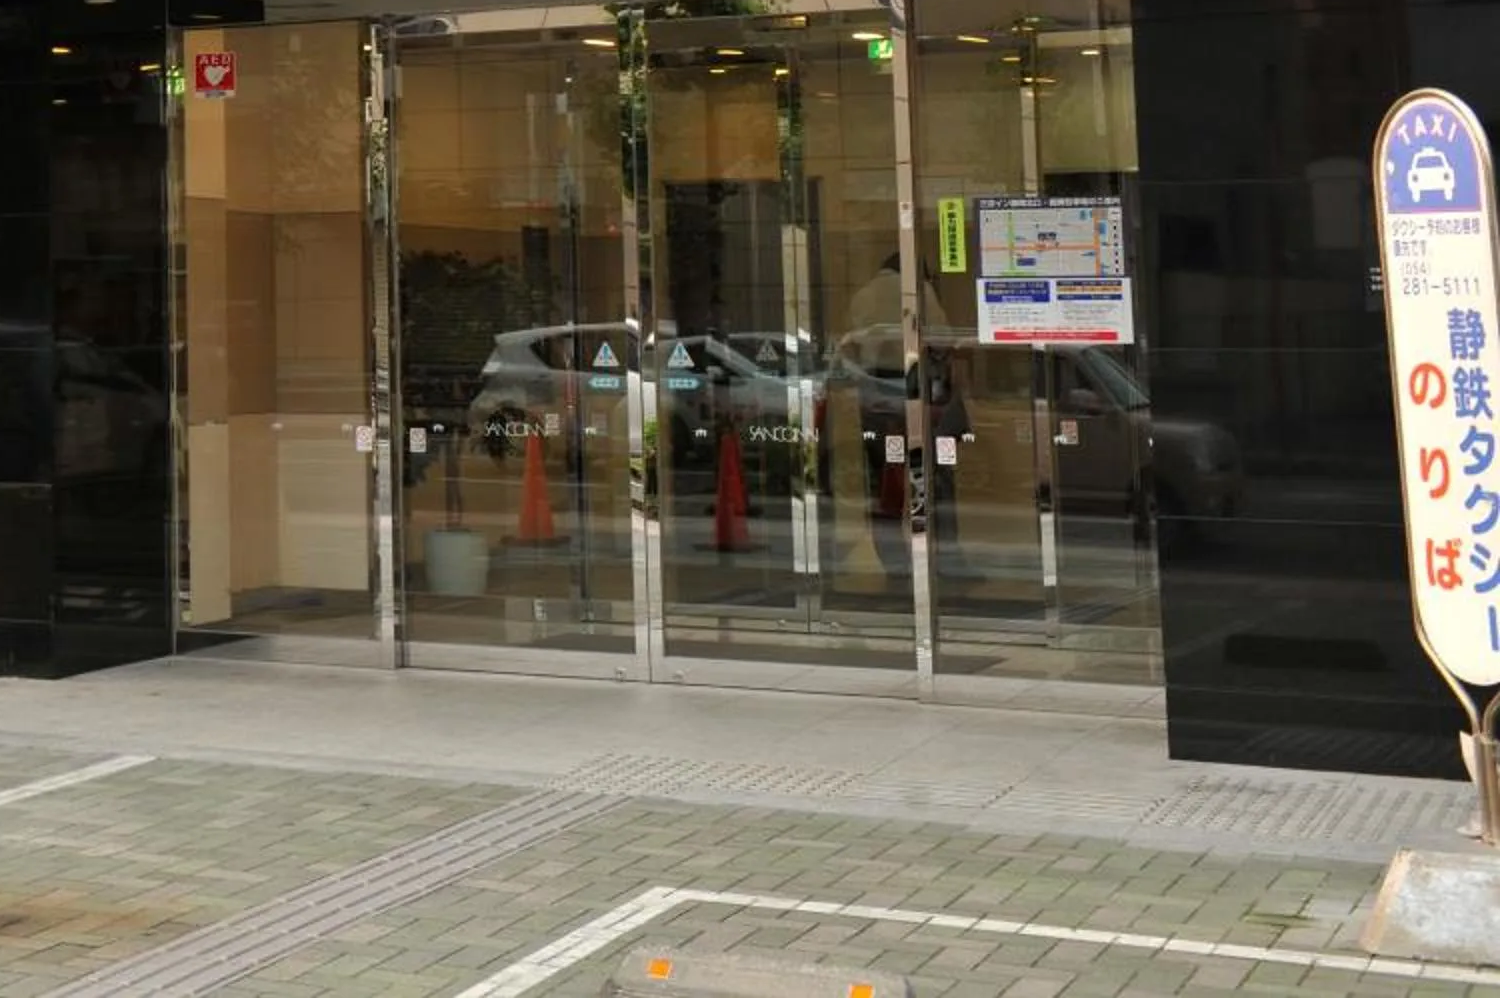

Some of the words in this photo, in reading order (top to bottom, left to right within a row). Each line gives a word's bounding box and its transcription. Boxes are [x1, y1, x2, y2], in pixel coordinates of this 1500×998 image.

[199, 55, 231, 65] AED
[1397, 113, 1458, 145] TAXI
[1402, 277, 1481, 296] 281-5111
[1408, 361, 1463, 591] のりば
[1446, 308, 1500, 652] 静鉄タクシー
